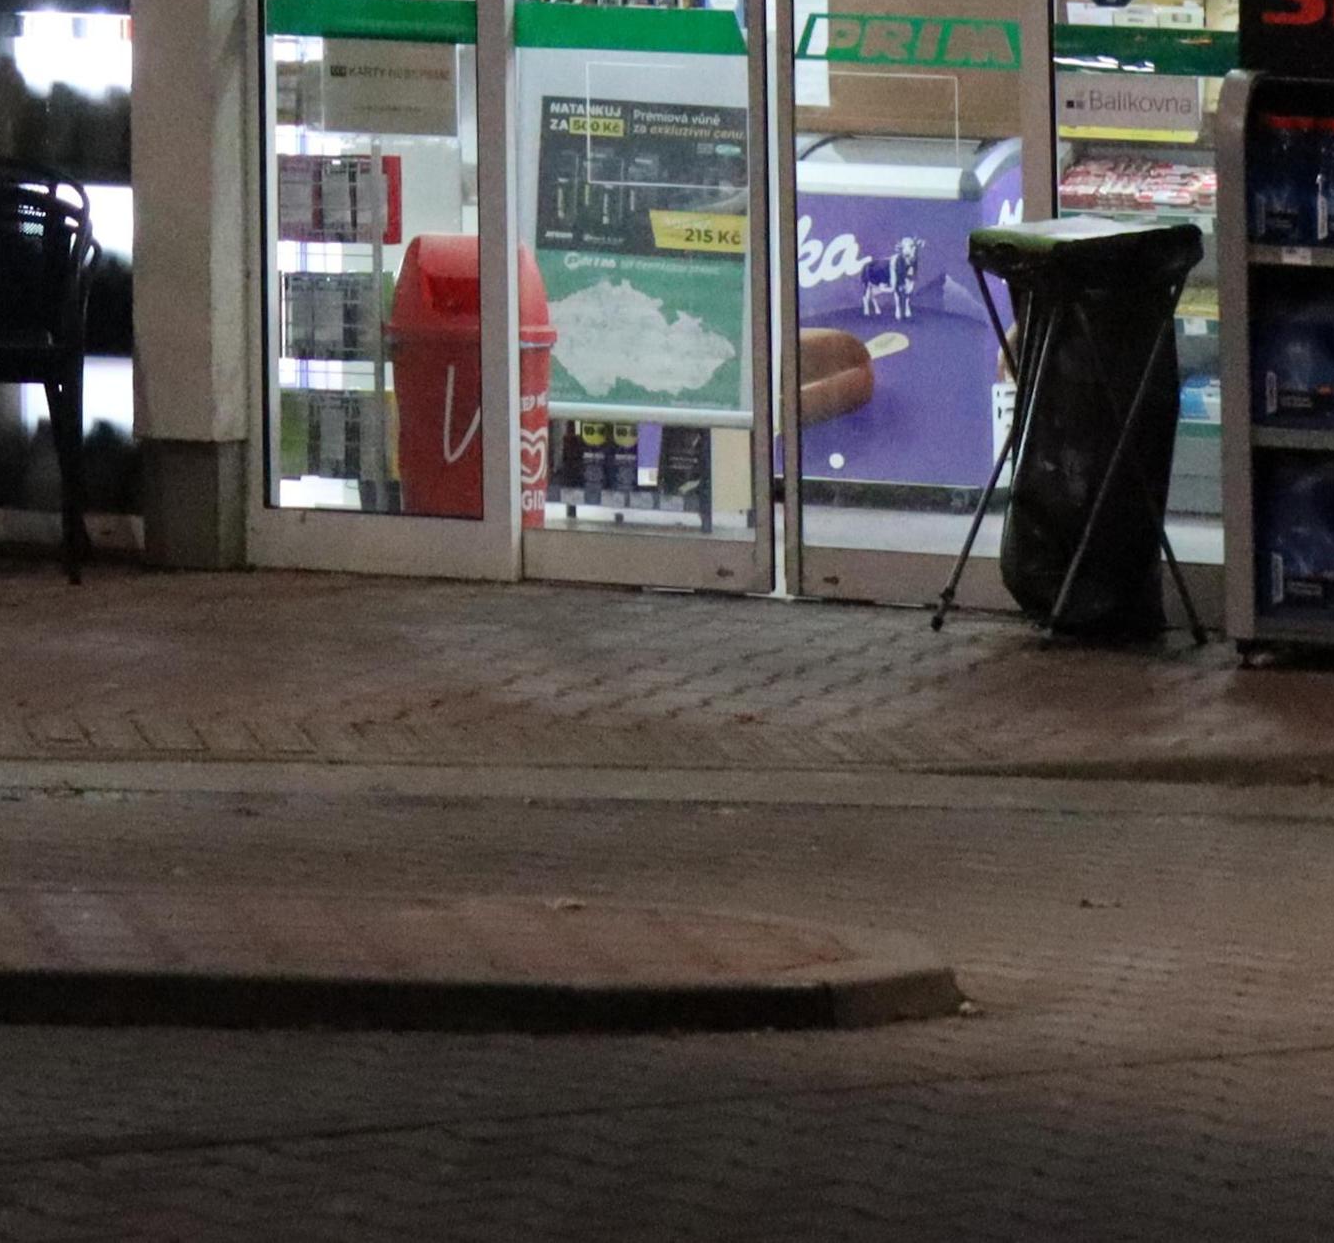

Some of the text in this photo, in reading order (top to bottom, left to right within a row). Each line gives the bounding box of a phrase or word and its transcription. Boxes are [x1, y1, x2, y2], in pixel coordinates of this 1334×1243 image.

[550, 101, 622, 117] NATANKUJ
[549, 118, 622, 134] ZA 500 Kč
[683, 228, 742, 246] 215 Kč
